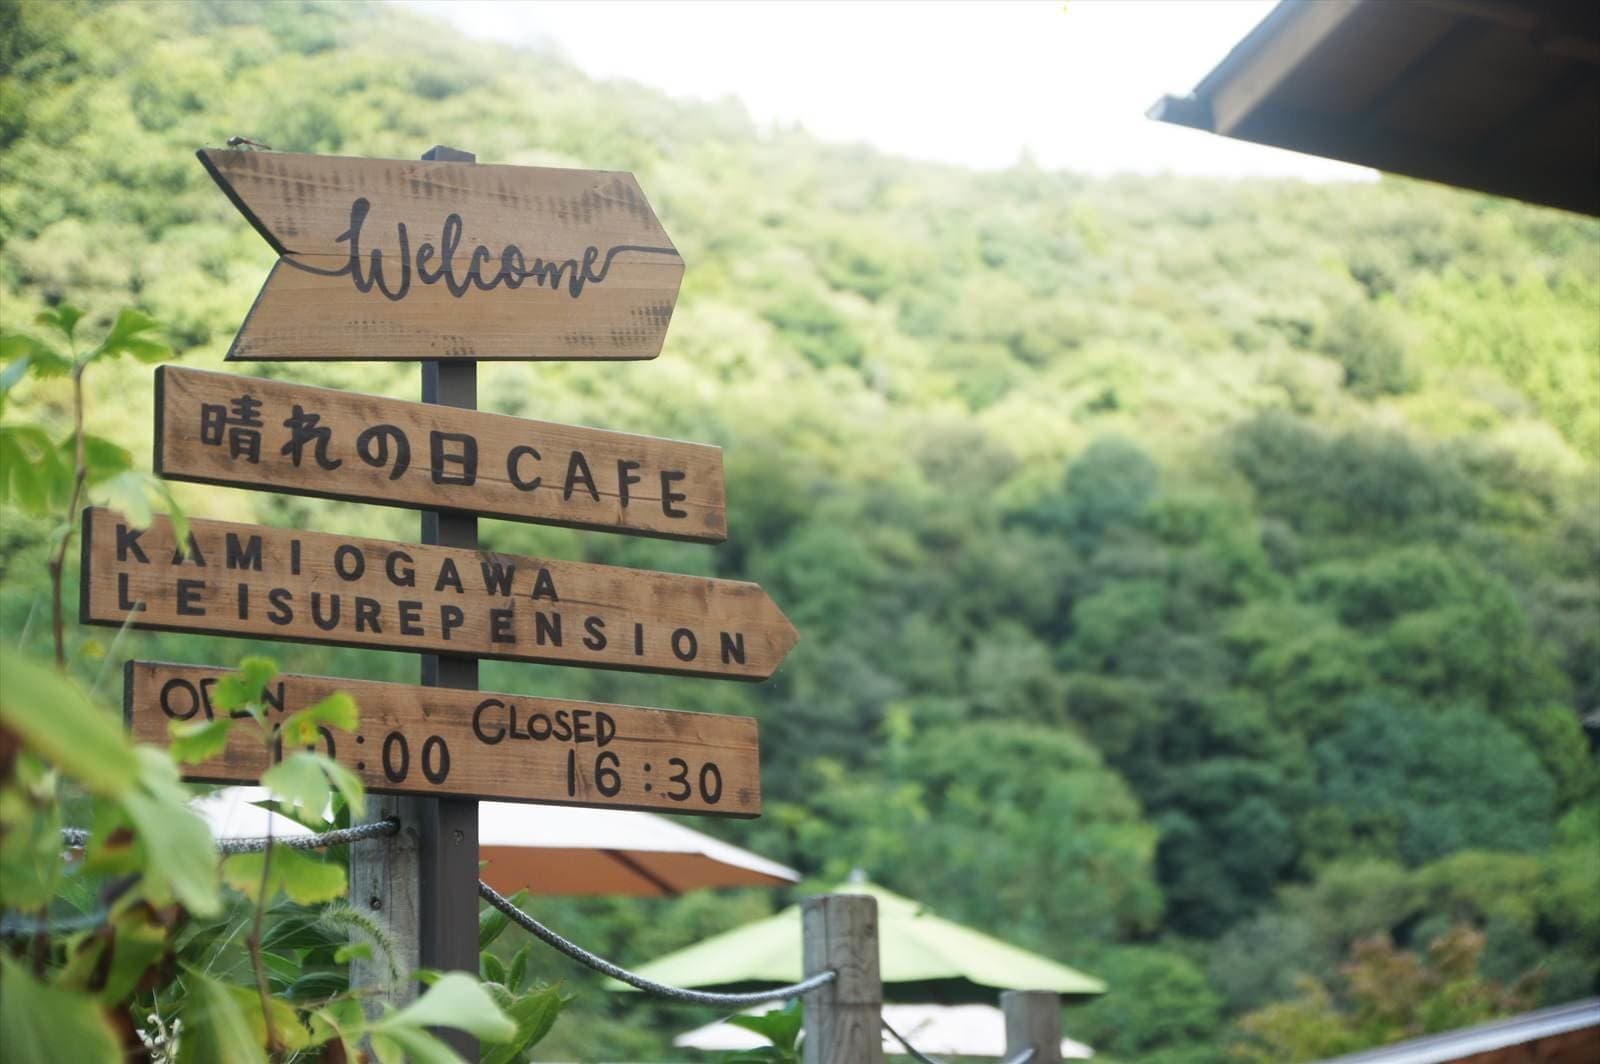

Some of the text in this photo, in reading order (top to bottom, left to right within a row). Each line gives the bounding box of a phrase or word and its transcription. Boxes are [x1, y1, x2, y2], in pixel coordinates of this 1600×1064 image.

[281, 198, 680, 300] Welcome
[116, 523, 559, 602] KAMIOGAWA
[118, 573, 746, 665] LEISUREPENSION
[160, 678, 285, 721] OPN
[472, 699, 616, 747] CLOSED
[567, 748, 723, 804] 16:30
